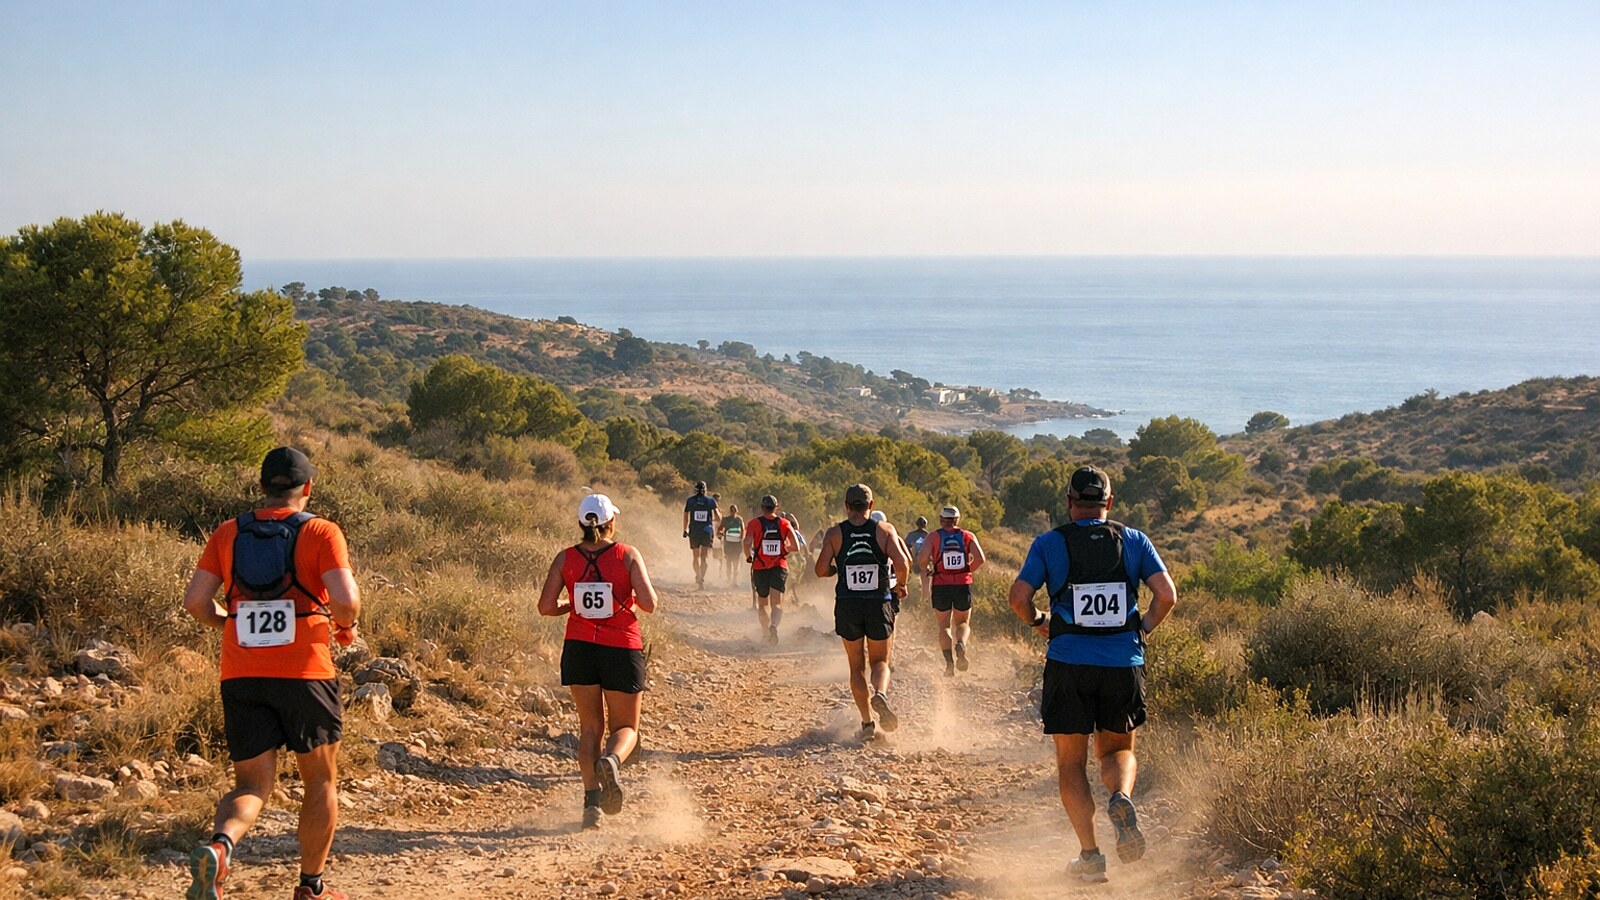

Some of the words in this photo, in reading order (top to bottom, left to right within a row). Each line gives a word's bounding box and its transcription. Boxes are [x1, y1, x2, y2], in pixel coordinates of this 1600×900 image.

[851, 571, 873, 584] 187
[582, 591, 604, 609] 65
[1080, 594, 1119, 615] 204
[246, 610, 286, 634] 128
